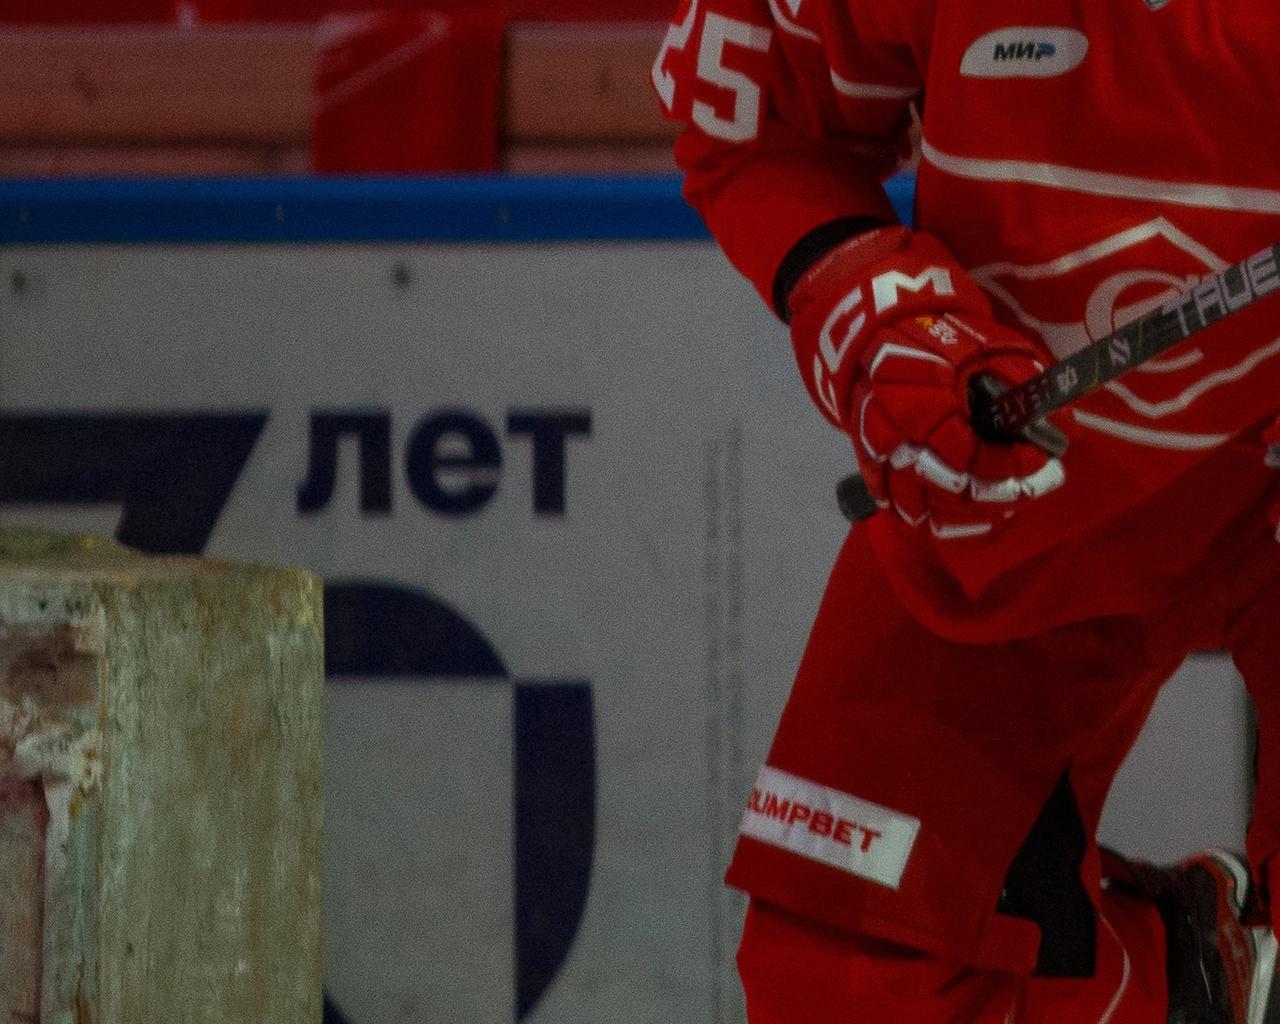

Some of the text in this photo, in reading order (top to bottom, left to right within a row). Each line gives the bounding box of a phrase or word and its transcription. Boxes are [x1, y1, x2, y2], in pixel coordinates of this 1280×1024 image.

[993, 42, 1056, 61] МИР
[813, 266, 956, 423] CCM
[296, 411, 593, 516] лет
